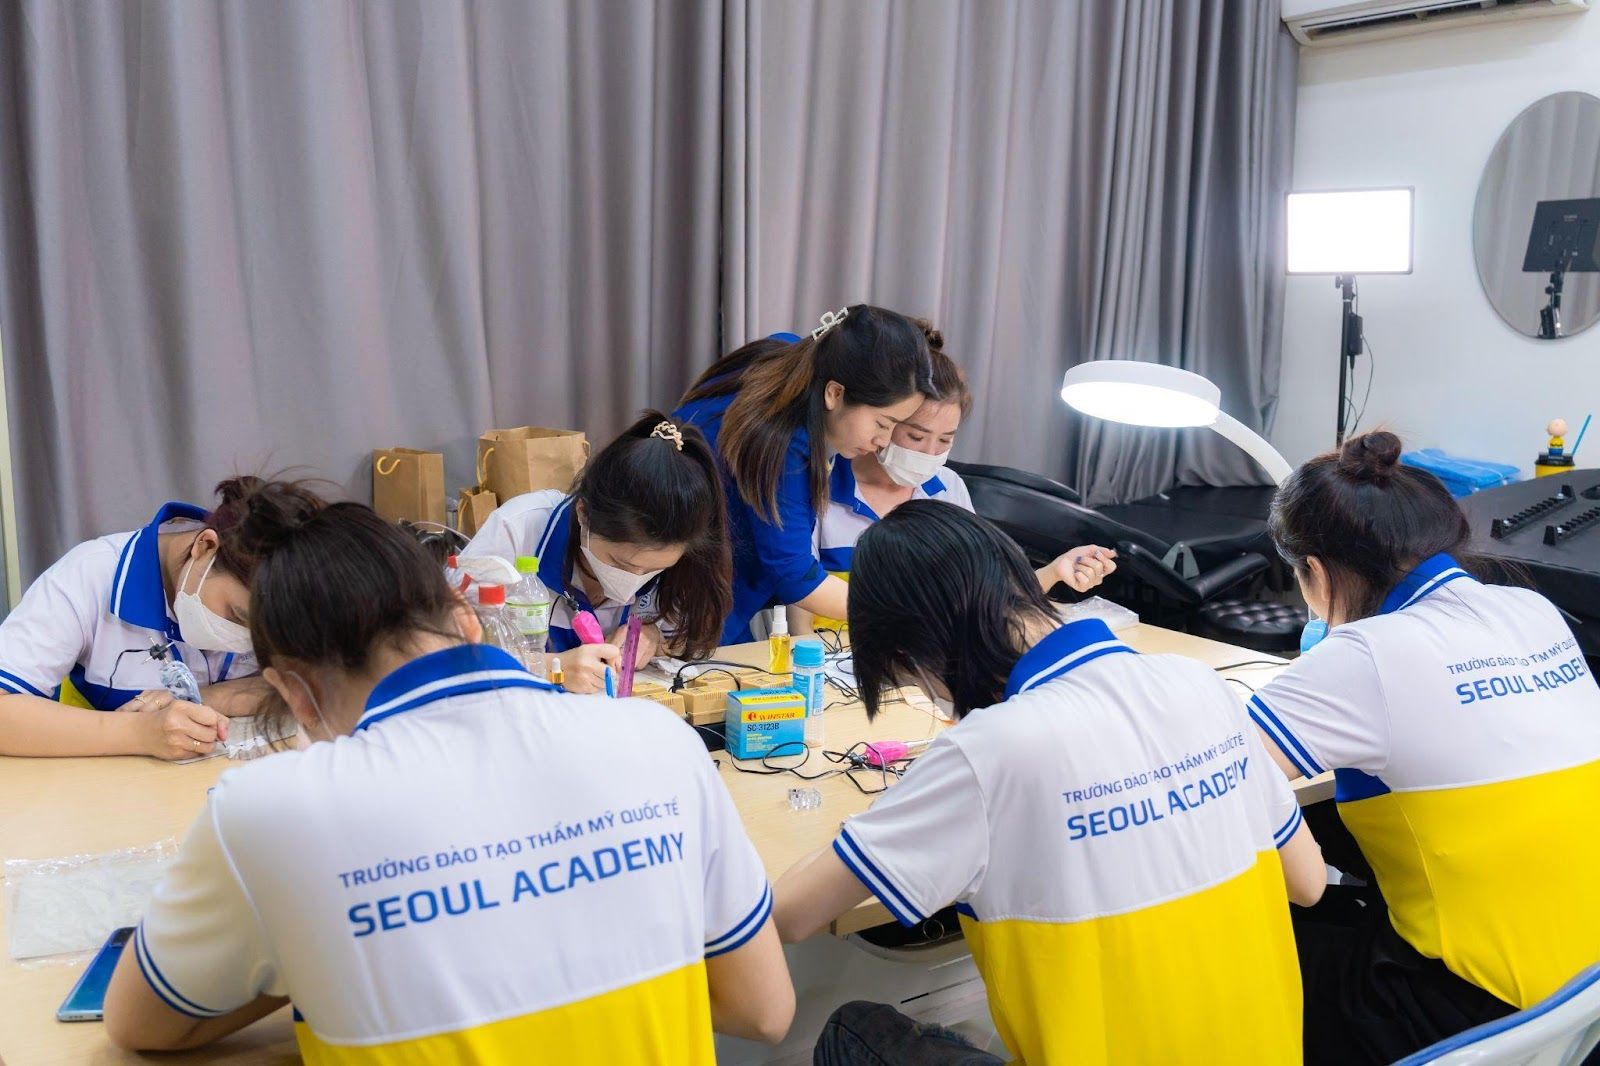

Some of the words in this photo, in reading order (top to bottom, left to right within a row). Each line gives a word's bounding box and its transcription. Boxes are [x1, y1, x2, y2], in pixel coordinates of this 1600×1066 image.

[1455, 675, 1534, 705] SEOUL
[1532, 655, 1588, 691] ACADE
[759, 712, 796, 721] WINSTAR
[1062, 780, 1123, 804] TRƯỜNG
[1124, 773, 1148, 790] ĐÀO
[1066, 798, 1164, 841] SEOUL
[338, 855, 431, 889] TRƯỜNG
[436, 844, 478, 868] ĐÀO
[482, 839, 523, 859] TẠO
[620, 799, 662, 824] QUỐC
[348, 879, 500, 938] SEOUL
[512, 831, 685, 903] ACADEMY
